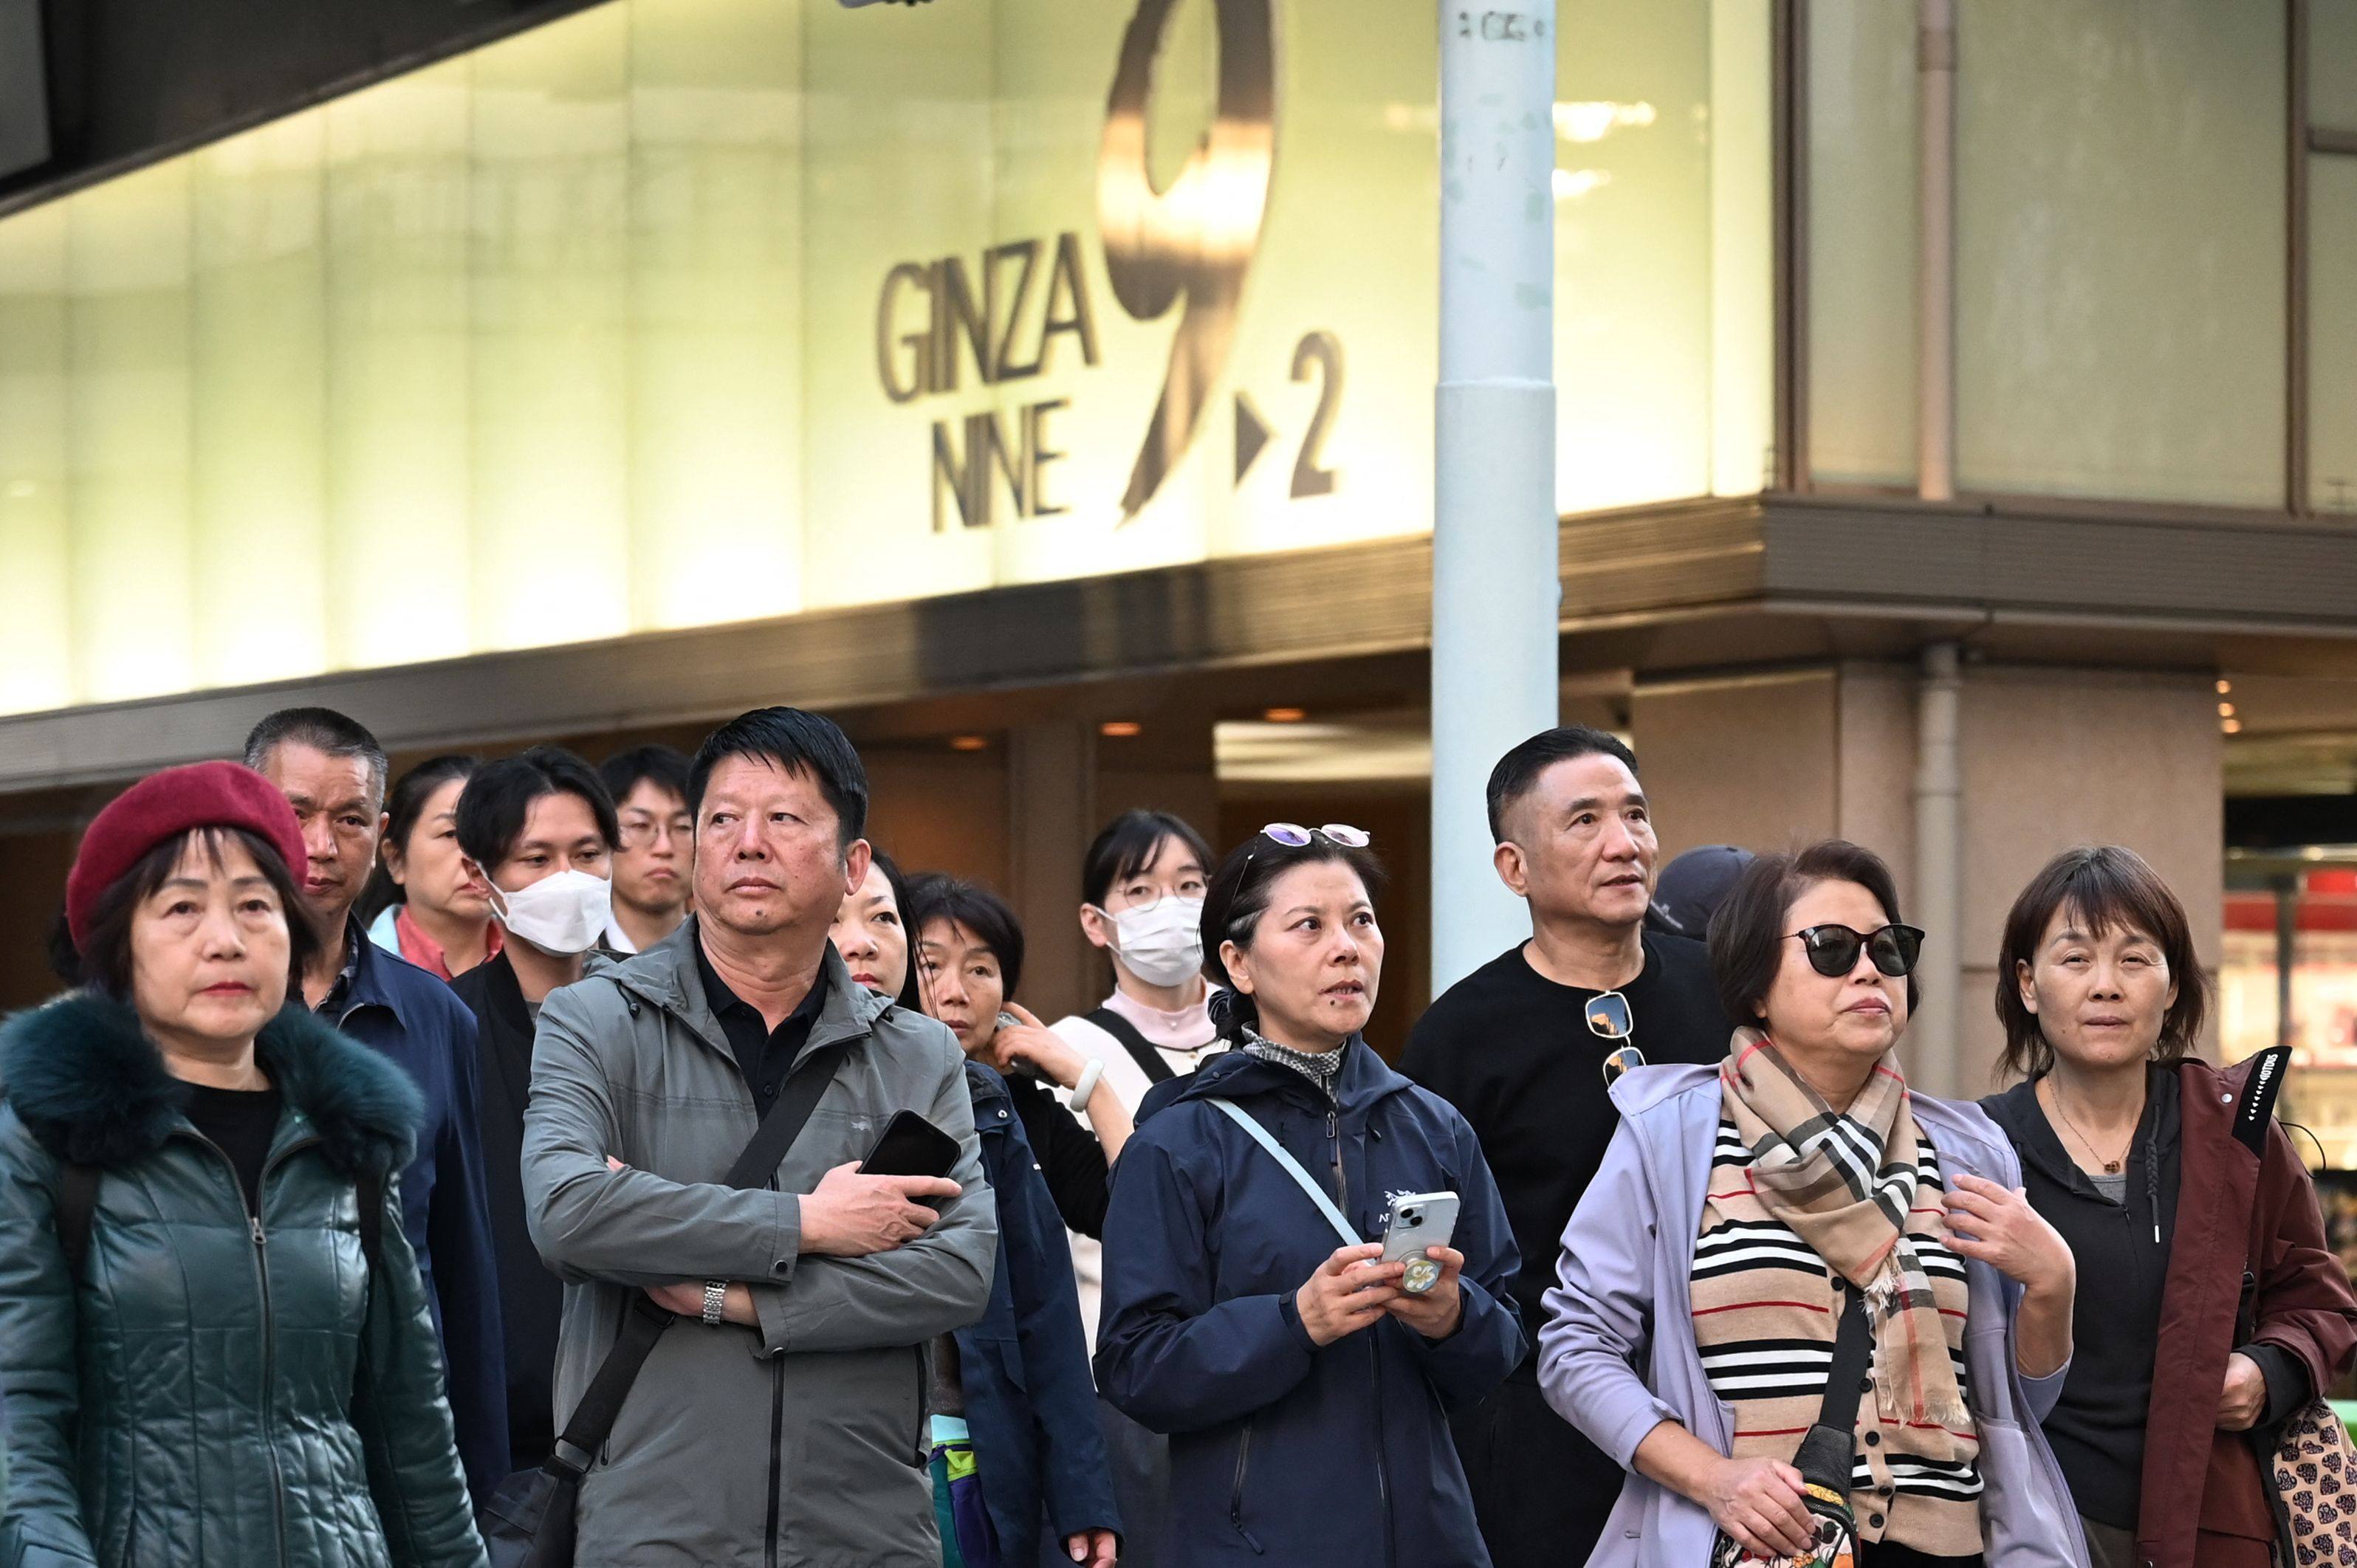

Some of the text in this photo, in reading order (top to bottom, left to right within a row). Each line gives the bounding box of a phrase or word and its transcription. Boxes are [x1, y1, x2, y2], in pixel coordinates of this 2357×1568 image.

[876, 232, 1100, 404] GINZA
[1096, 0, 1279, 529] 9
[931, 397, 1071, 533] NINE
[1289, 329, 1343, 498] 2
